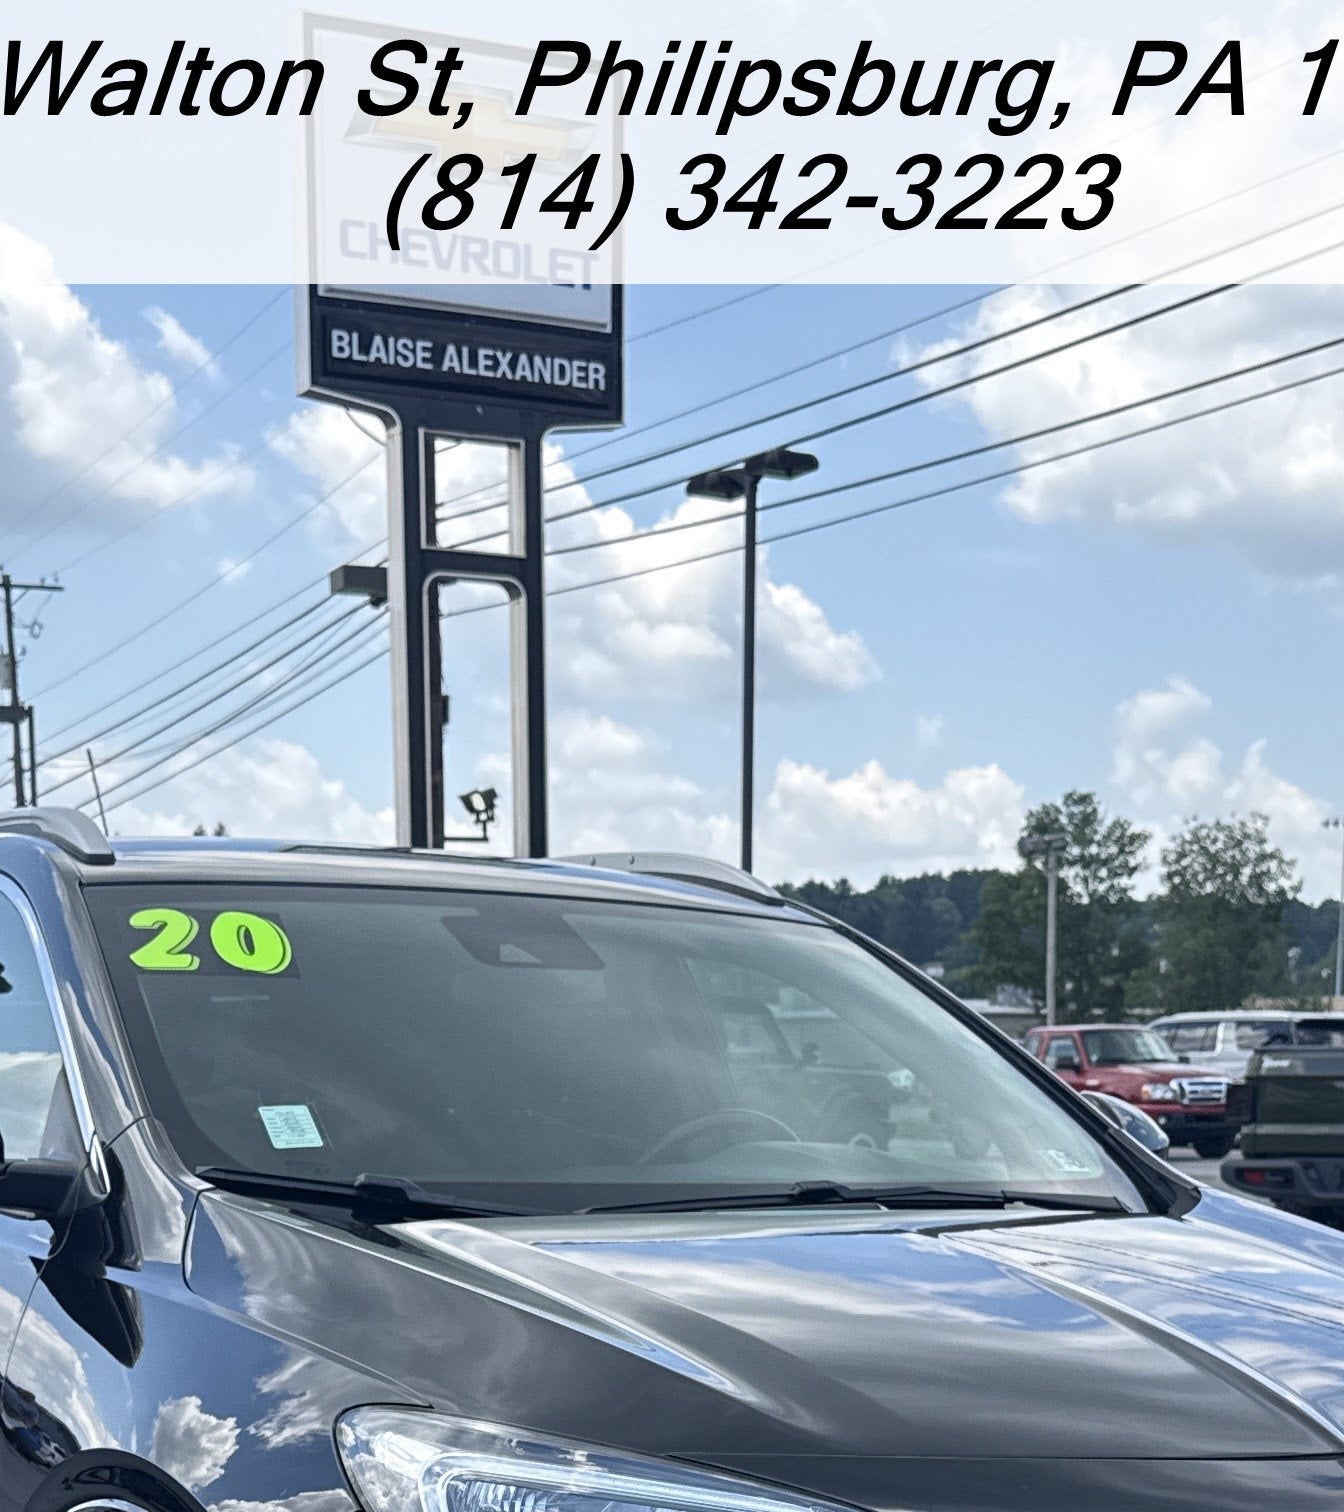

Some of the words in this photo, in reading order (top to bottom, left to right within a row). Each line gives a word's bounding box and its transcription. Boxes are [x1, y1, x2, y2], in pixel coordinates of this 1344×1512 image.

[339, 218, 600, 290] CHEVROLET
[330, 328, 434, 371] BLAISE
[441, 344, 607, 391] ALEXANDER
[129, 907, 293, 975] 20
